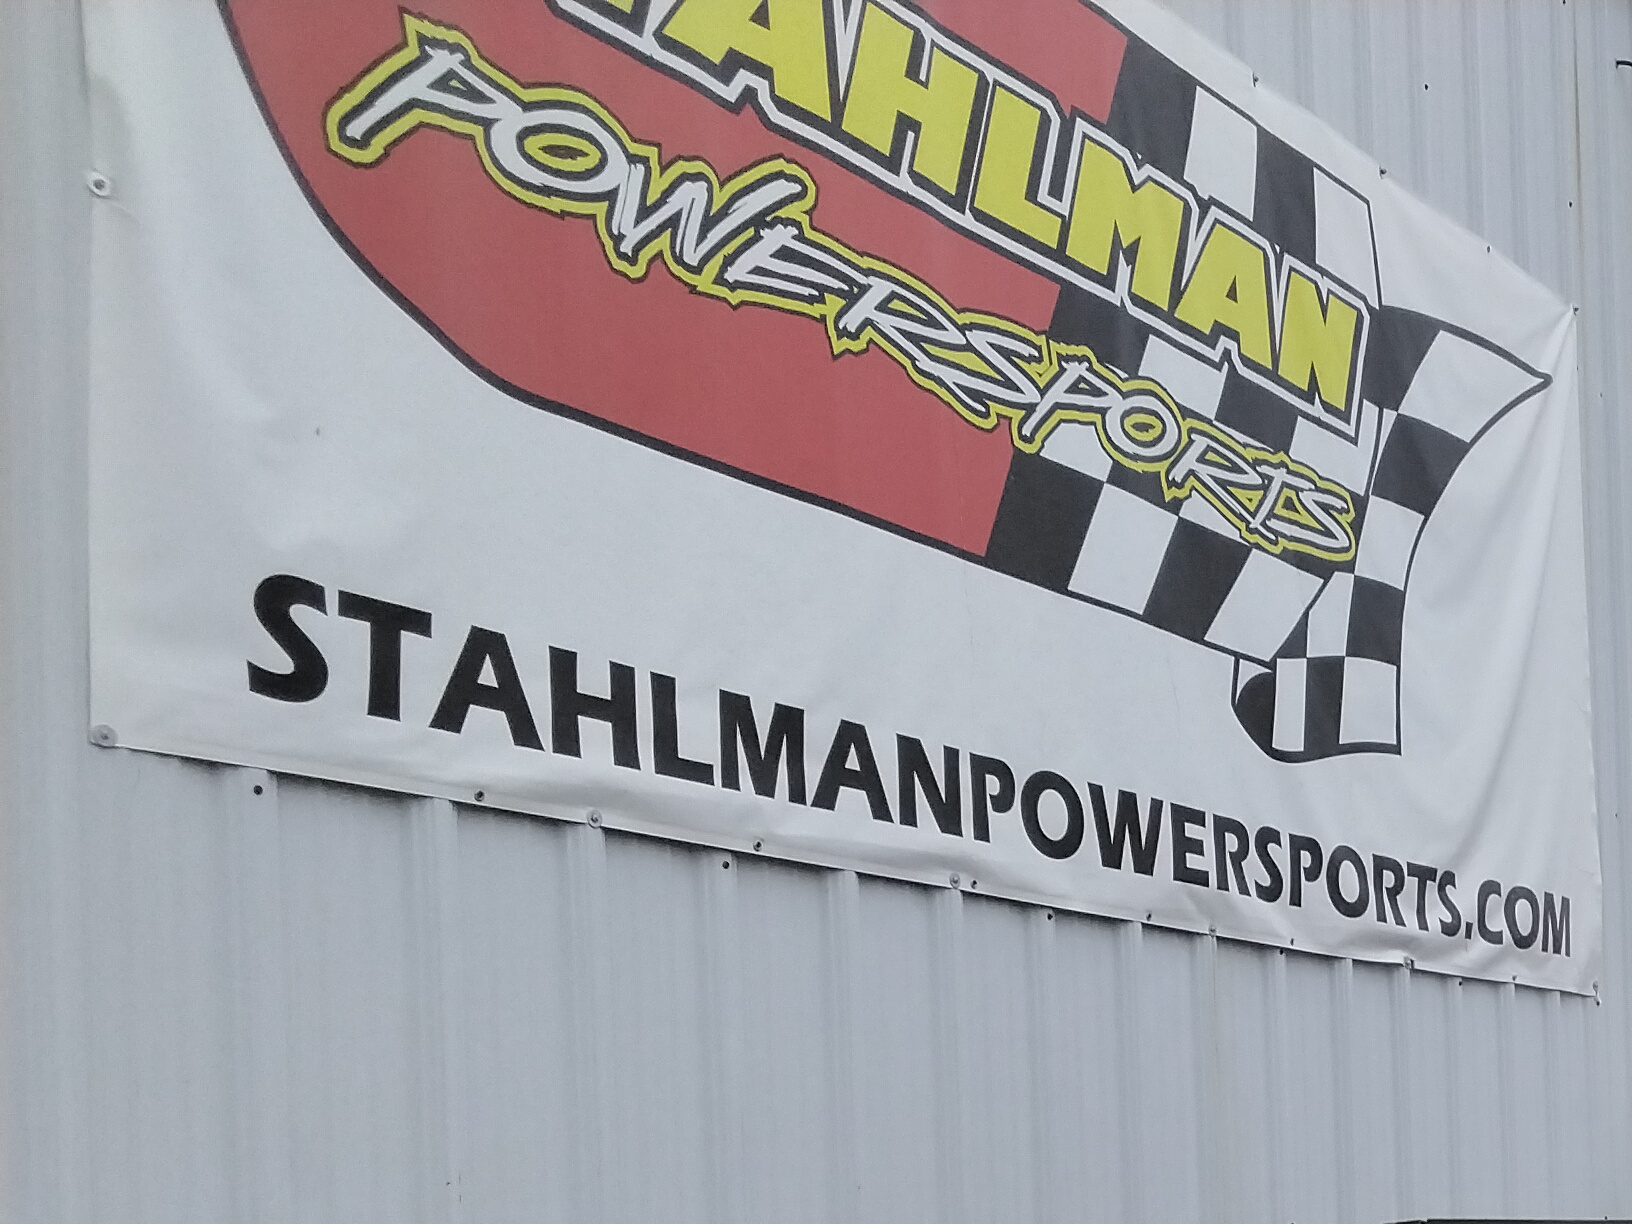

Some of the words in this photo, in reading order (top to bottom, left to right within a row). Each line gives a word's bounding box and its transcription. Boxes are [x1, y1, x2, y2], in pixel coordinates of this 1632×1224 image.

[334, 28, 1354, 560] POWERSPORTS
[600, 0, 1362, 414] AHLMAN
[246, 573, 1571, 958] STAHLMANPOWERSPORTS.COM
